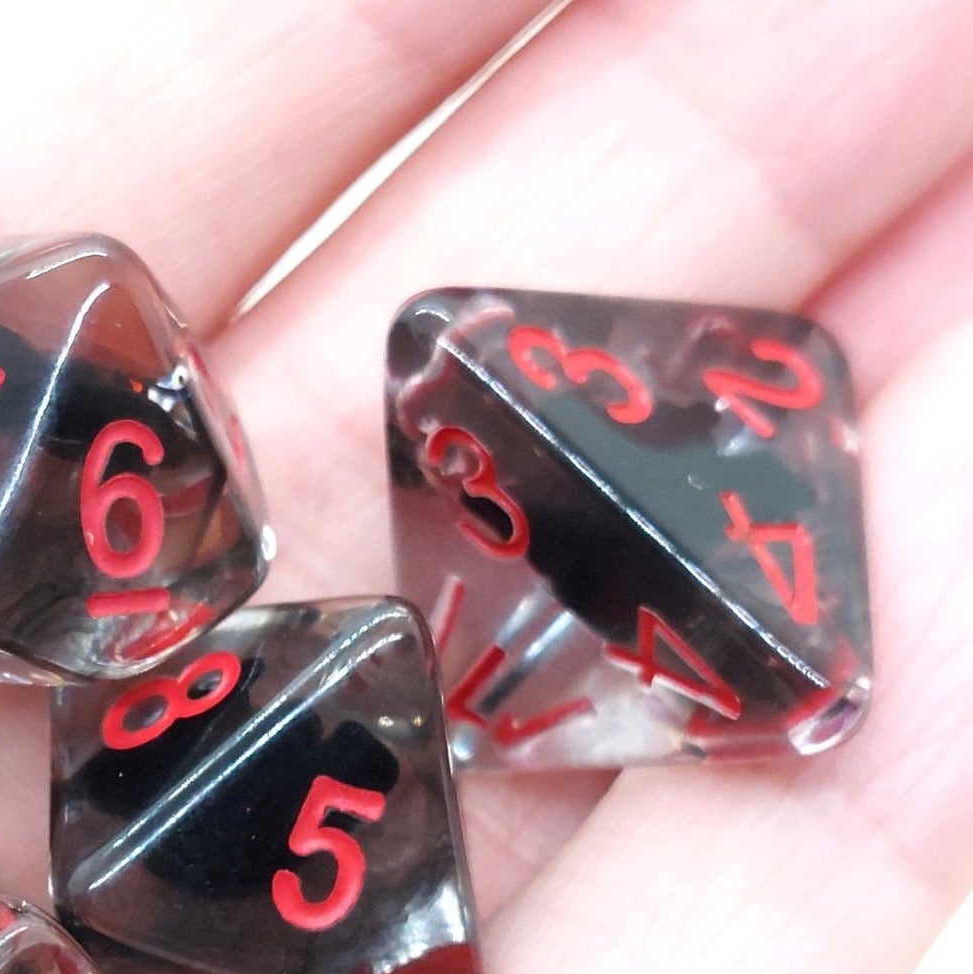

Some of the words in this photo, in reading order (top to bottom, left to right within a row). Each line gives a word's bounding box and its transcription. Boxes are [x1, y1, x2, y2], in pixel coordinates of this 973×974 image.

[507, 326, 654, 424] 3
[703, 339, 823, 438] 2
[427, 427, 530, 558] 3
[721, 491, 818, 624] 4
[101, 651, 243, 750] 8
[604, 605, 741, 720] 4
[271, 774, 387, 931] 5
